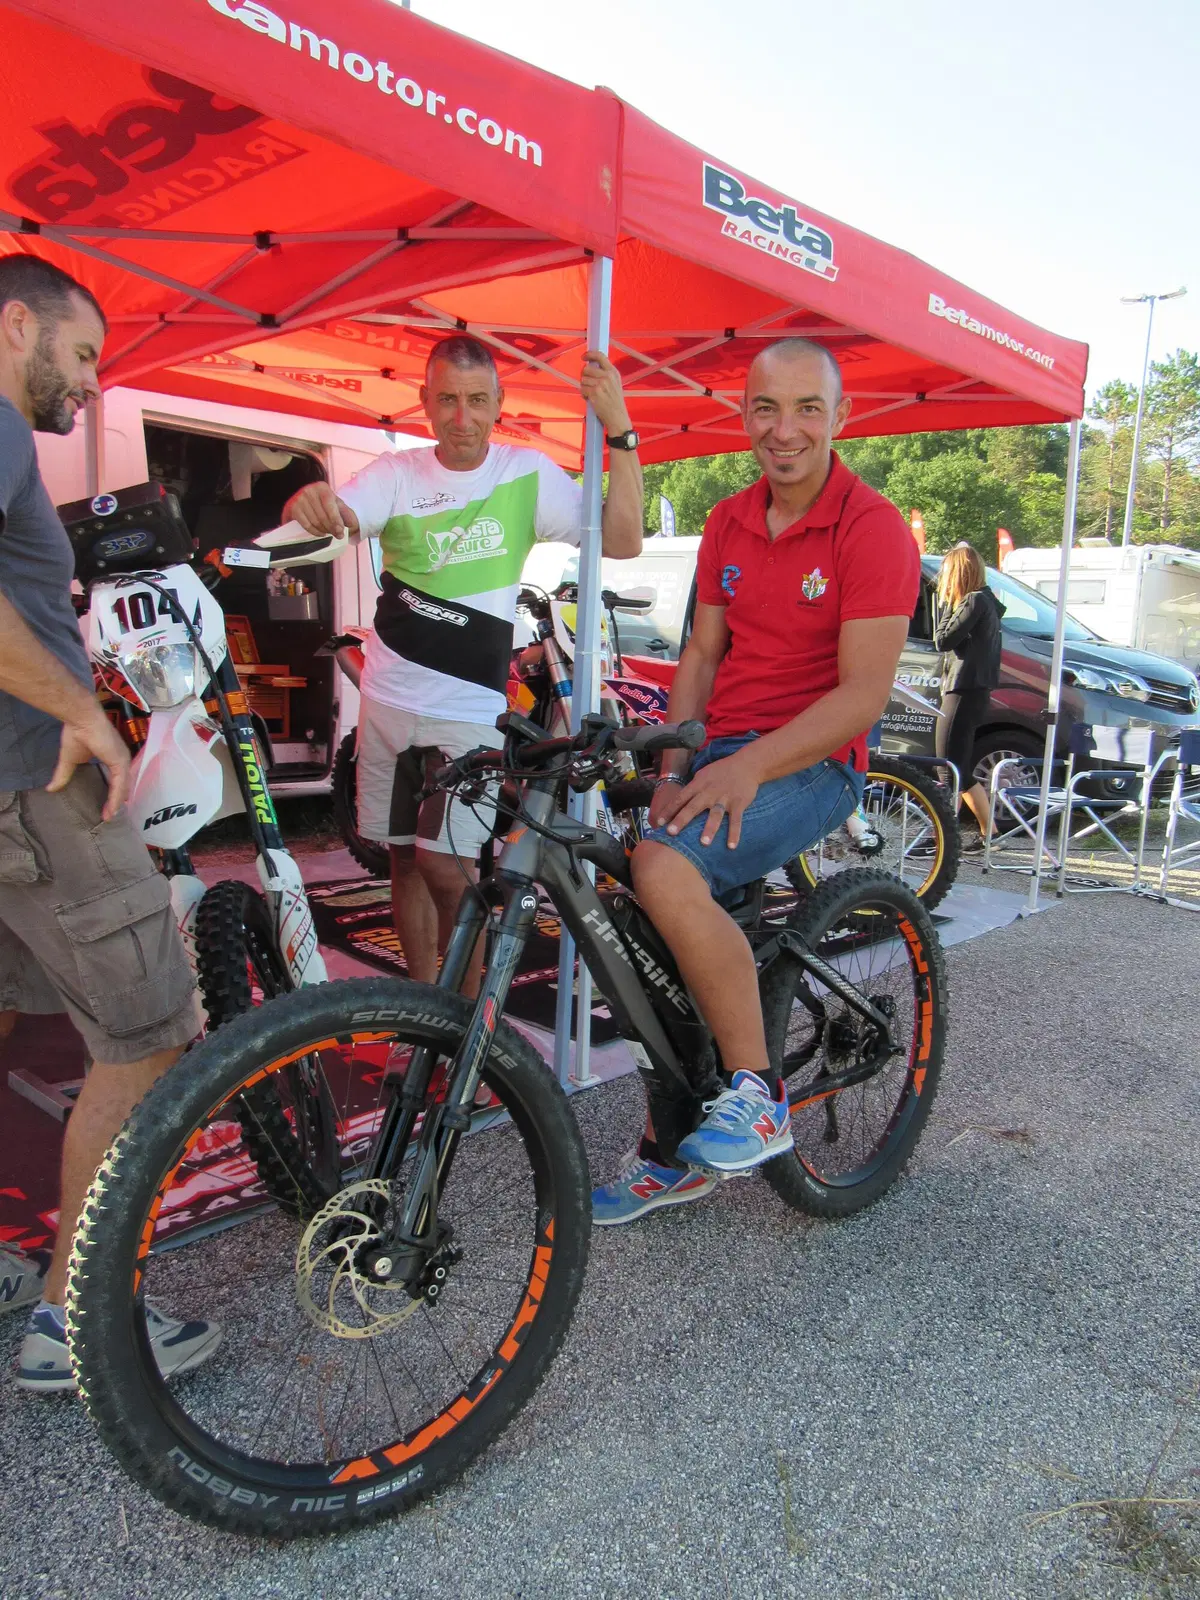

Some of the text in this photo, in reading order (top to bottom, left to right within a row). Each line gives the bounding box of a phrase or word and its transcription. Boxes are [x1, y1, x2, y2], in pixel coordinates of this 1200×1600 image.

[704, 164, 833, 262] Beta
[723, 221, 803, 264] RACING
[928, 293, 1055, 370] Betamotor.com
[110, 588, 184, 635] 104
[143, 639, 161, 649] 2017
[881, 721, 932, 733] info@fujiauto.it
[891, 714, 909, 722] 0171
[909, 716, 934, 724] 613312
[239, 743, 273, 824] PAIOLI
[143, 803, 198, 831] KTM
[351, 1010, 519, 1070] SCHWABE
